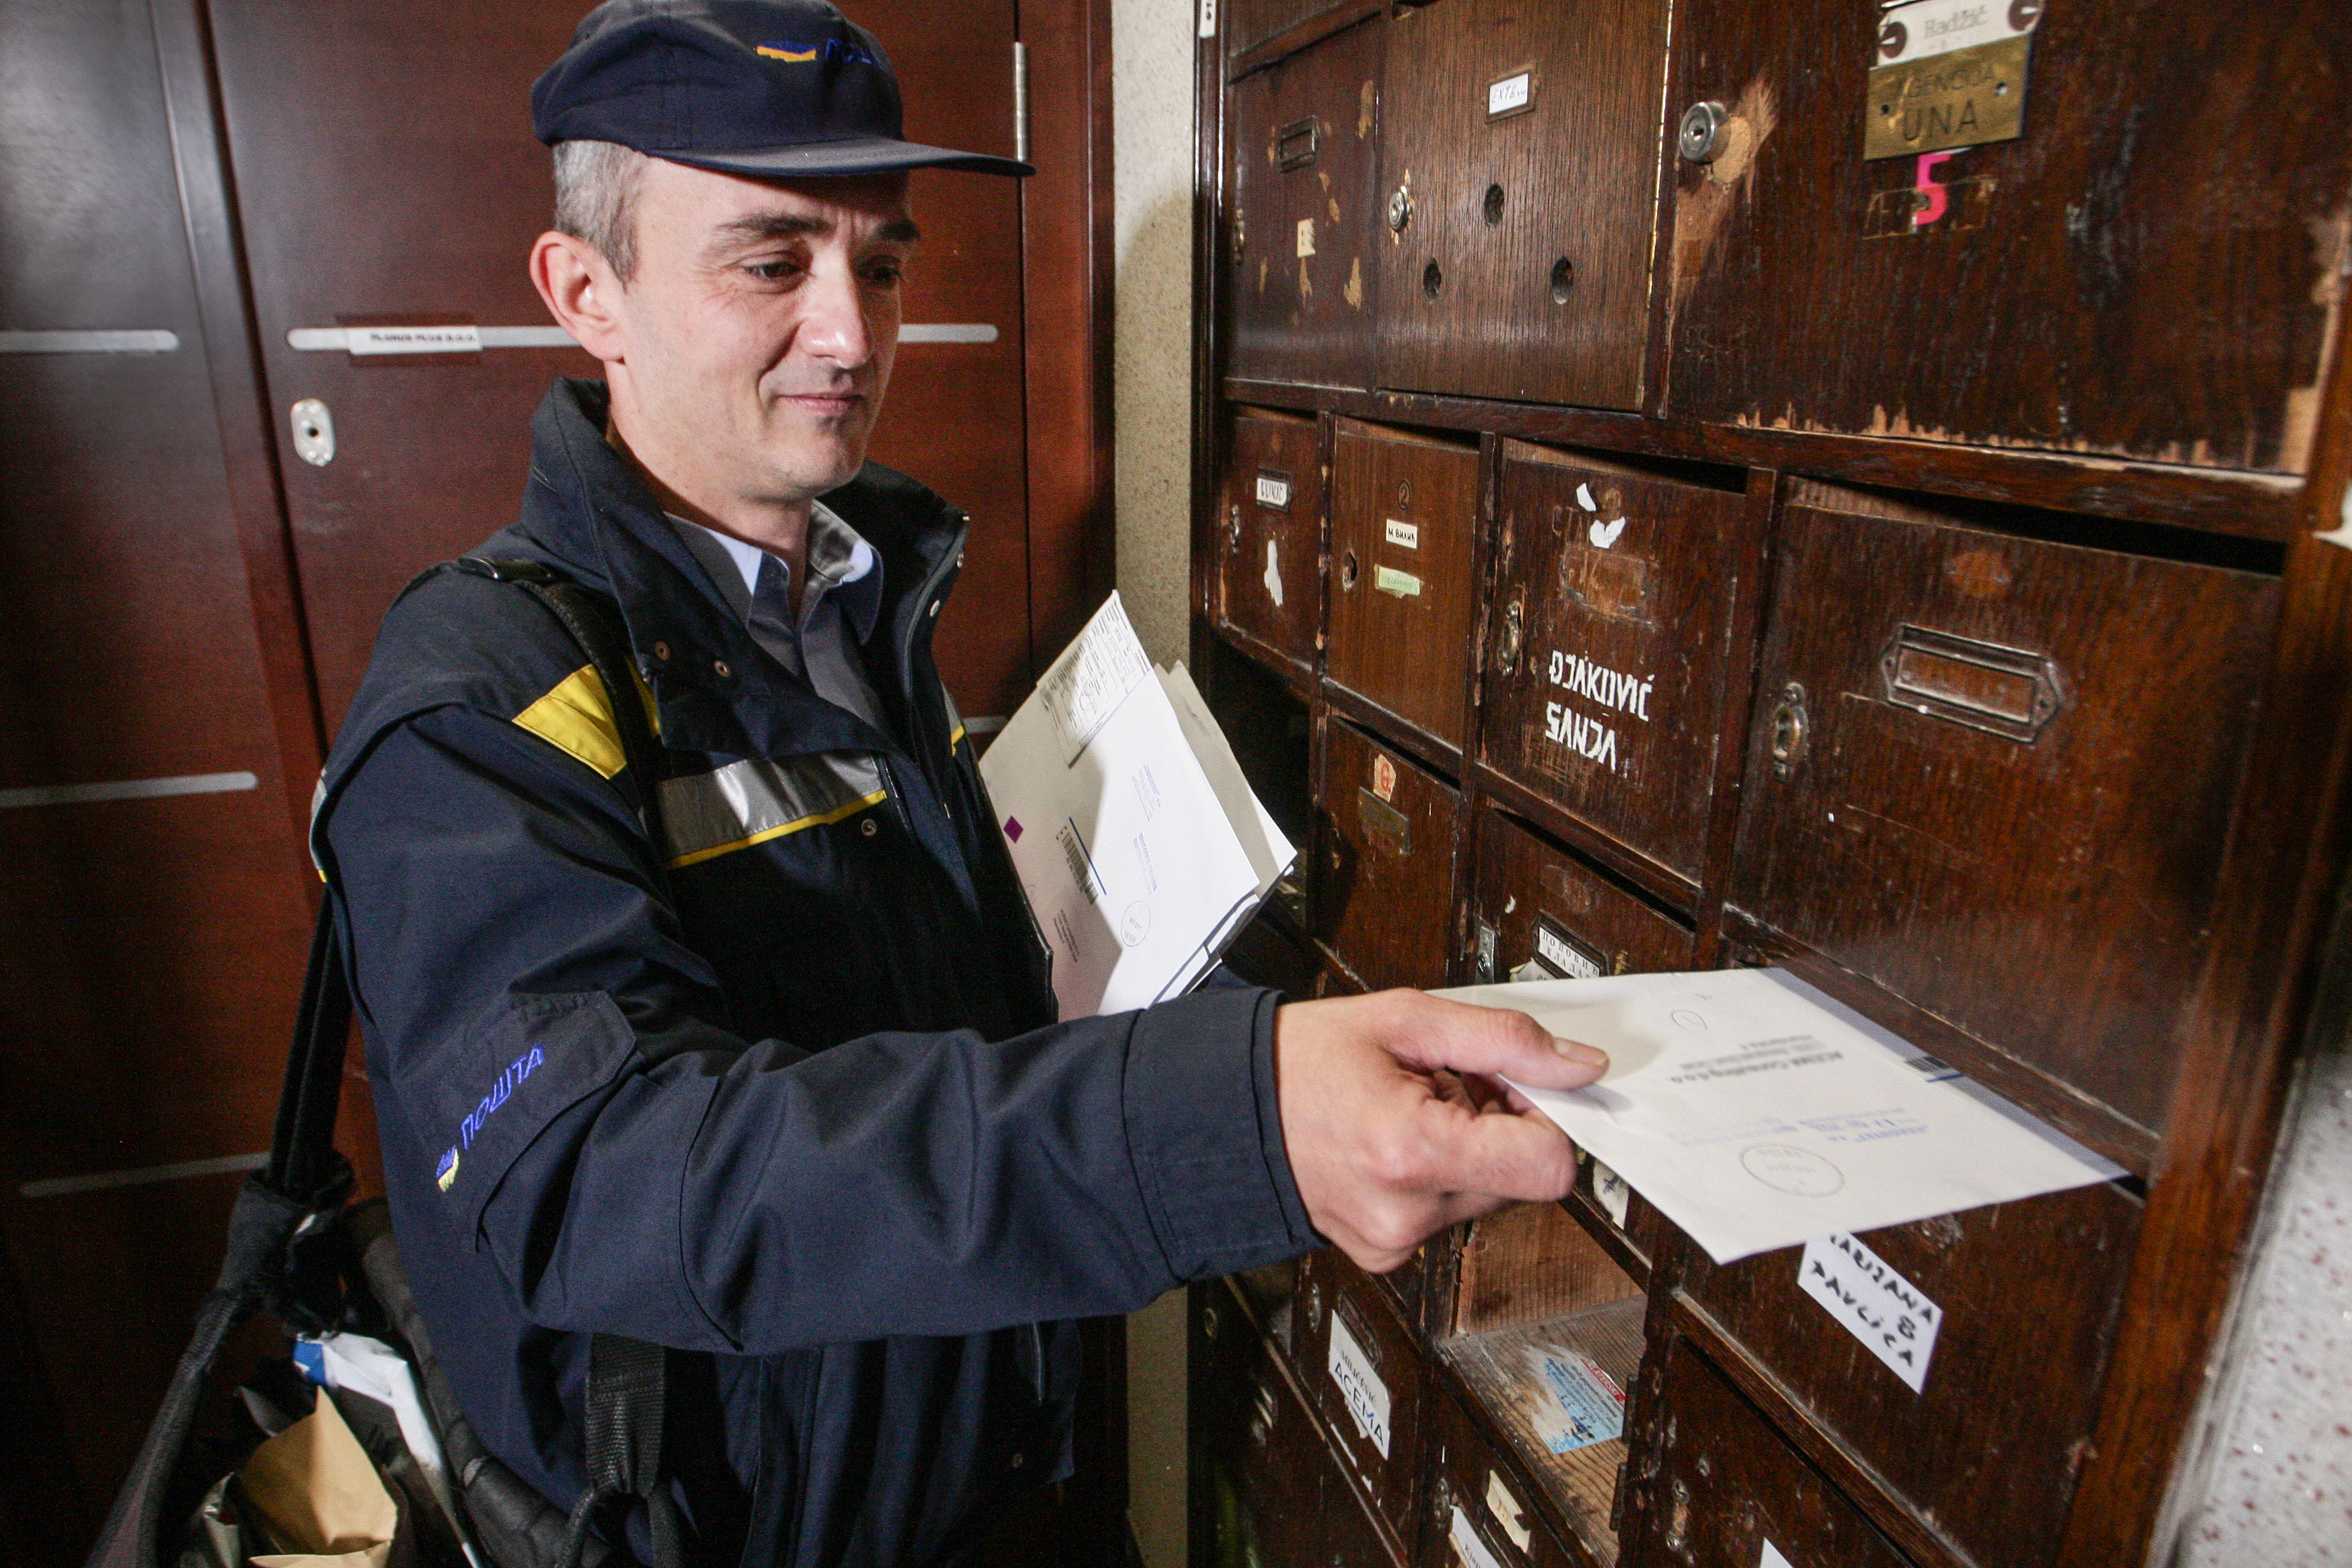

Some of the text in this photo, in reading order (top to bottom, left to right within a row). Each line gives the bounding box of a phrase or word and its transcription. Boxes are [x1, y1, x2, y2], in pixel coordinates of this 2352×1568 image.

[1903, 99, 1979, 142] UNA
[1915, 152, 1952, 226] 5
[1545, 701, 1616, 772] SANJA
[460, 1043, 544, 1150] ПОШТА
[1829, 1234, 1933, 1324] ARIJANA
